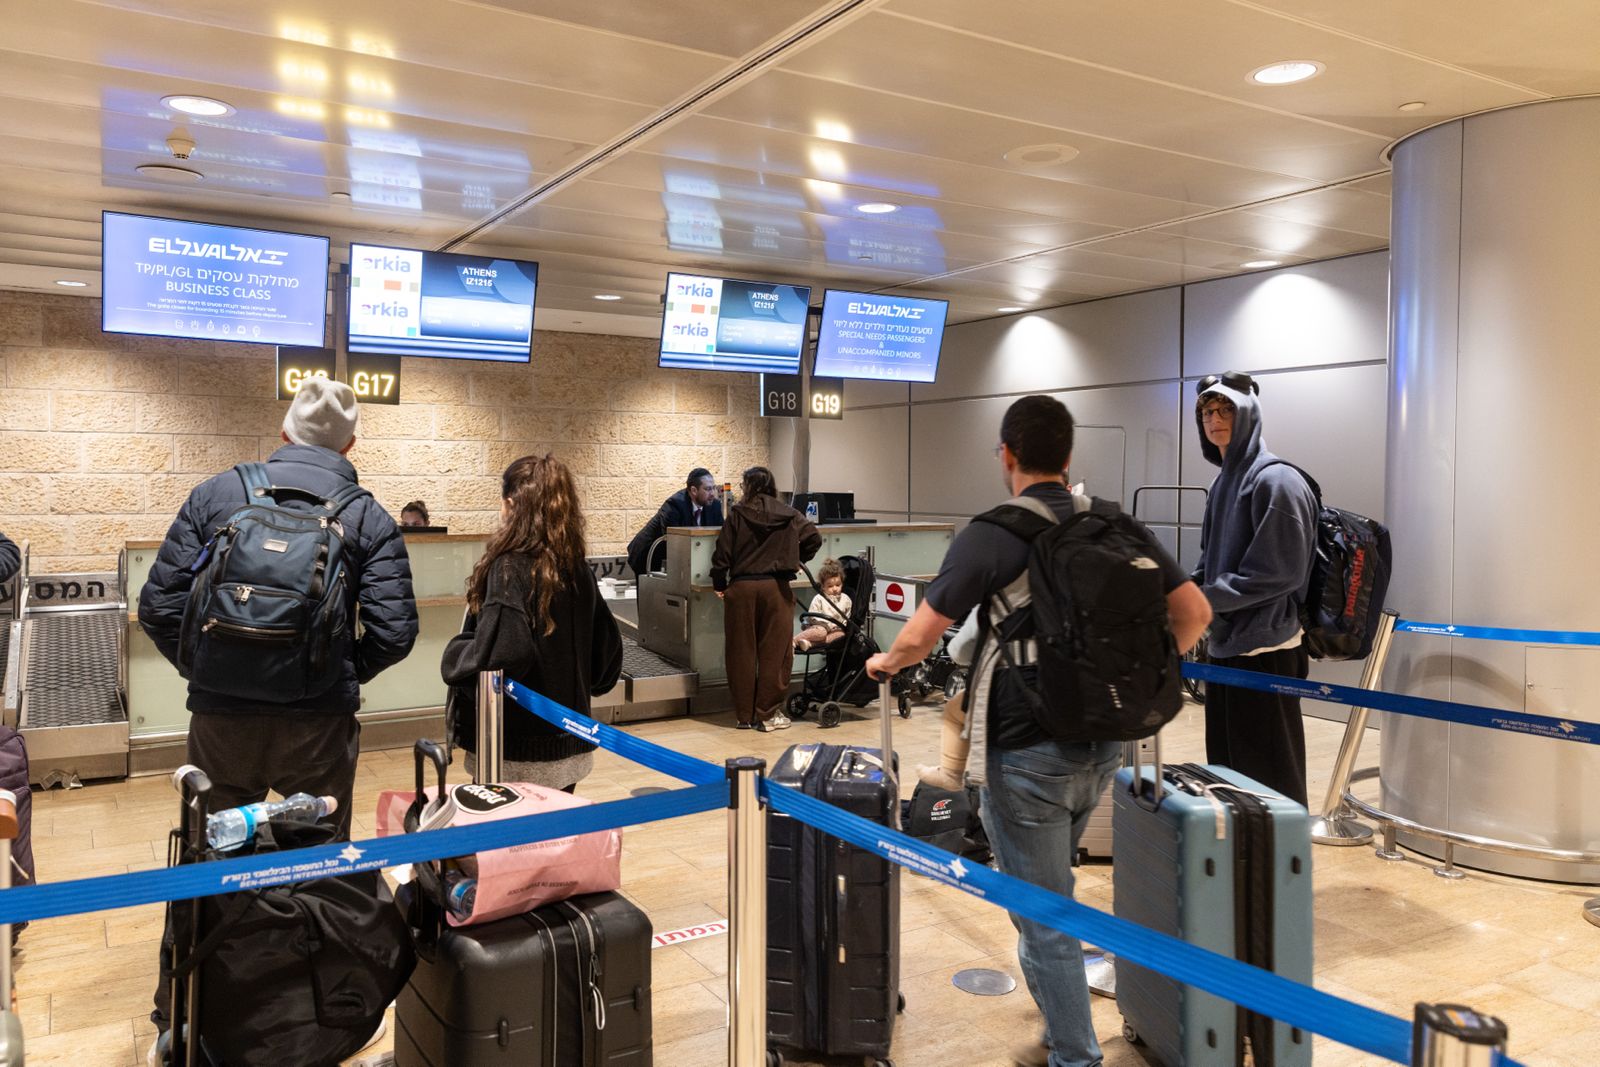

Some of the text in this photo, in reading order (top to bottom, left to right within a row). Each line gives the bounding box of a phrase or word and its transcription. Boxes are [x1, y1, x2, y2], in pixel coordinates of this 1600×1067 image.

[134, 262, 300, 288] מחלקת עסקים TP/PL/GL
[462, 267, 497, 278] ATHENS
[166, 281, 272, 300] BUSINESS CLASS
[752, 292, 779, 302] ATHENS
[838, 330, 926, 344] SPECIAL NEEDS PASSENGERS
[837, 346, 922, 360] UNACCOMPANIED MINORS
[353, 371, 395, 397] G17
[768, 391, 797, 410] G18
[812, 393, 841, 415] G19
[240, 859, 389, 888] BEN-GURION INTERNATIONAL AIRPORT
